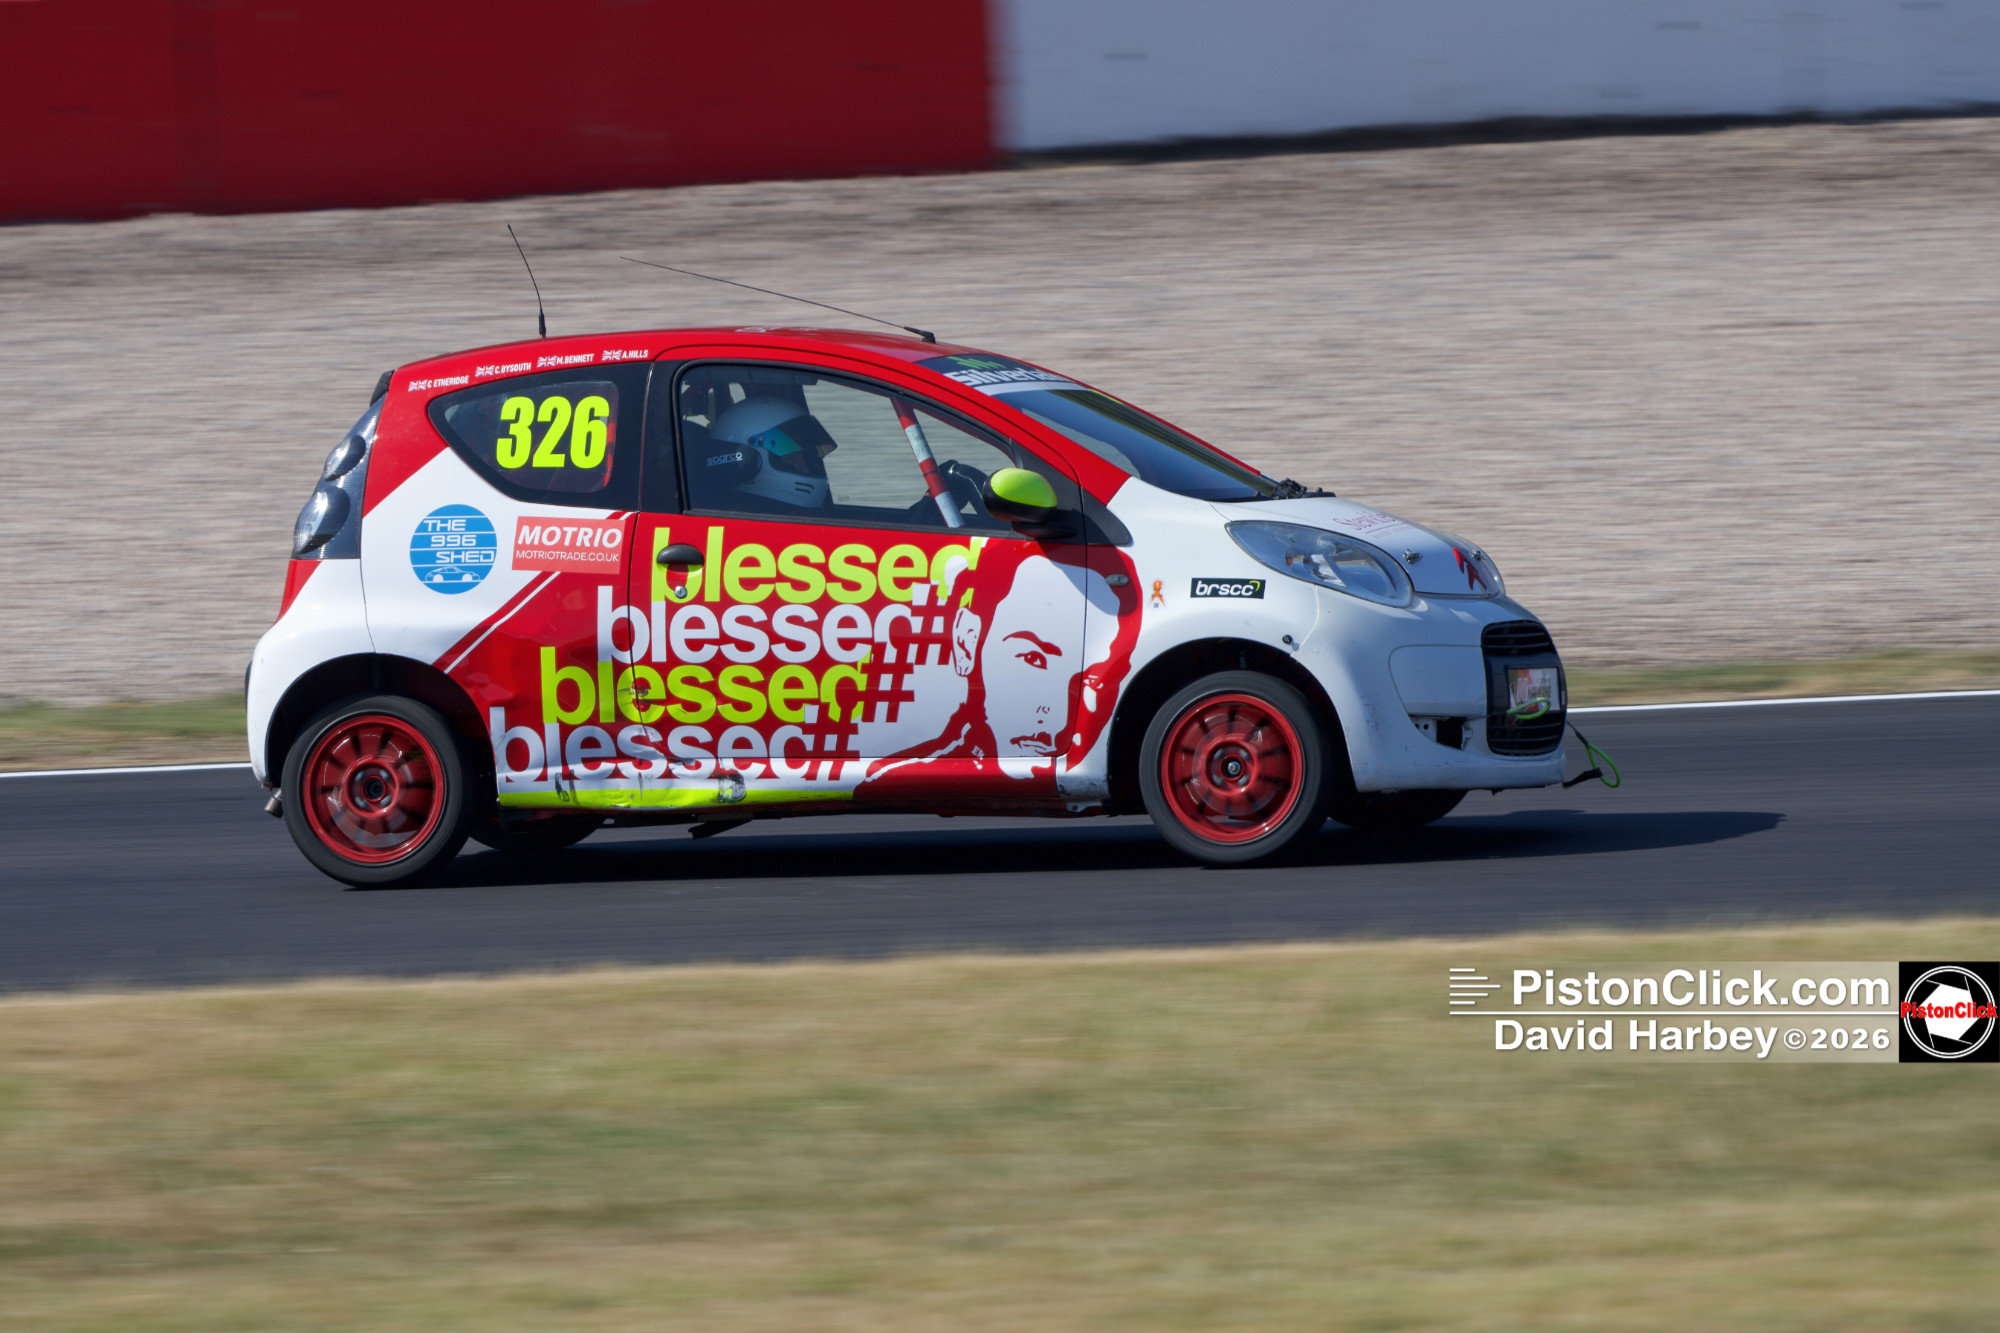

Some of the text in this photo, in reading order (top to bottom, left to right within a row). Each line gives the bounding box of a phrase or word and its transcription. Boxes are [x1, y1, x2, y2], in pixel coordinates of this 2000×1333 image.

[556, 353, 594, 365] M.BENNETT
[622, 349, 649, 359] A.HILLS
[494, 362, 532, 374] C.BYSOUTH
[433, 375, 469, 388] ETHERIDGE
[496, 396, 610, 469] 326
[423, 519, 467, 532] THE
[430, 534, 477, 547] 996
[517, 525, 622, 548] MOTRIO
[435, 550, 495, 564] SHED
[516, 550, 619, 563] MOTRIOTRADE.CO.UK
[1195, 580, 1254, 596] brscc
